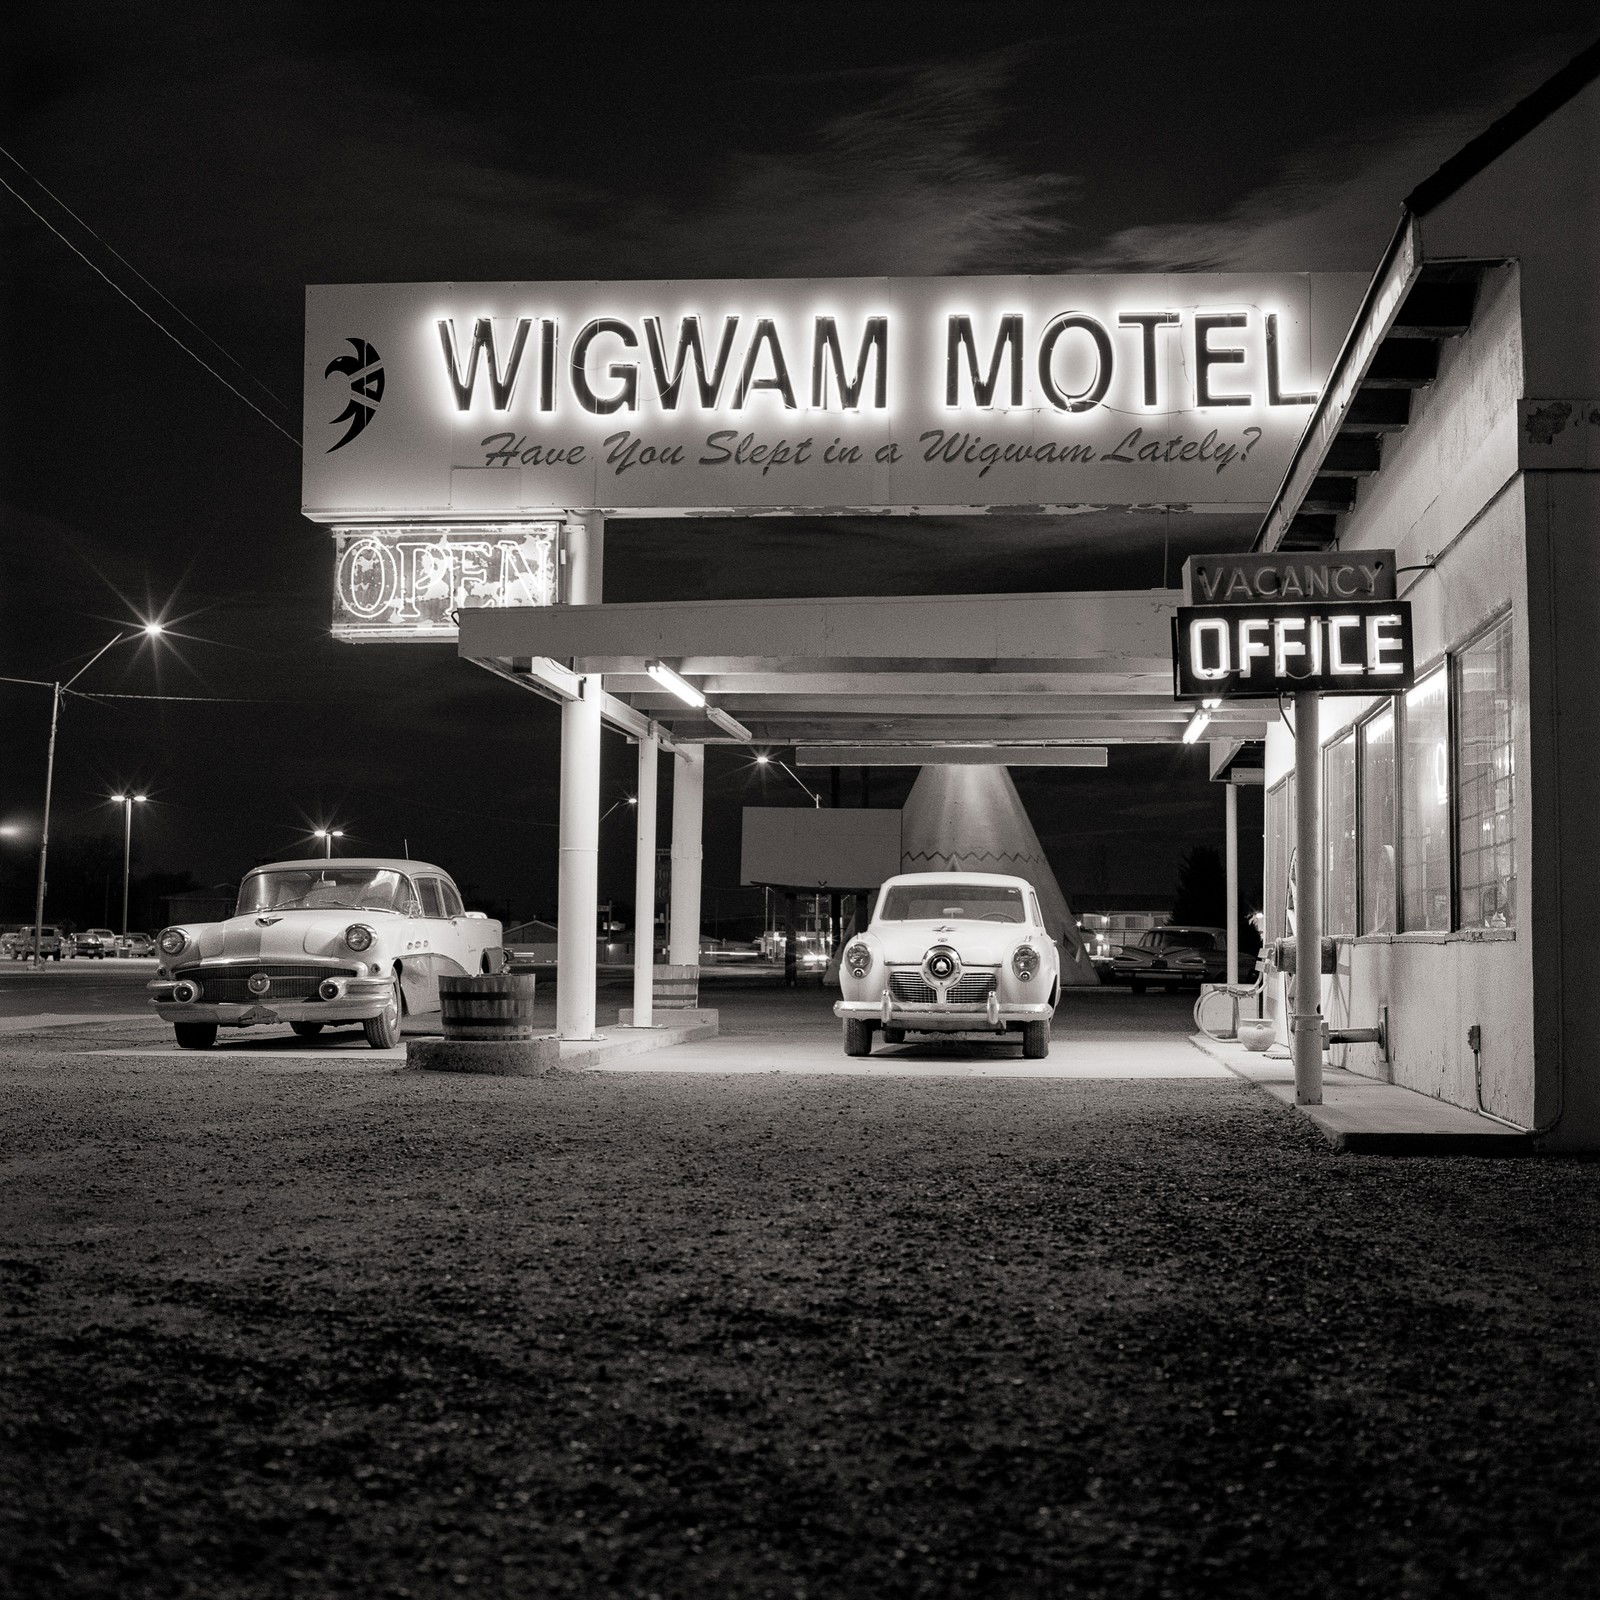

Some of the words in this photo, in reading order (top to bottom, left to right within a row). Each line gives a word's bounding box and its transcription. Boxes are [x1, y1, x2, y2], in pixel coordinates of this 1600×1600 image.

[434, 315, 889, 415] WIGWAM
[945, 310, 1321, 414] MOTEL
[480, 432, 586, 467] Have
[603, 431, 685, 475] You
[699, 430, 813, 476] Slept
[823, 436, 863, 463] in
[875, 442, 903, 464] a
[918, 430, 1096, 477] Wigwam
[1101, 426, 1263, 474] Lately?
[338, 538, 551, 618] OPEN
[1200, 566, 1382, 600] VACANCY
[1189, 614, 1404, 680] OFFICE
